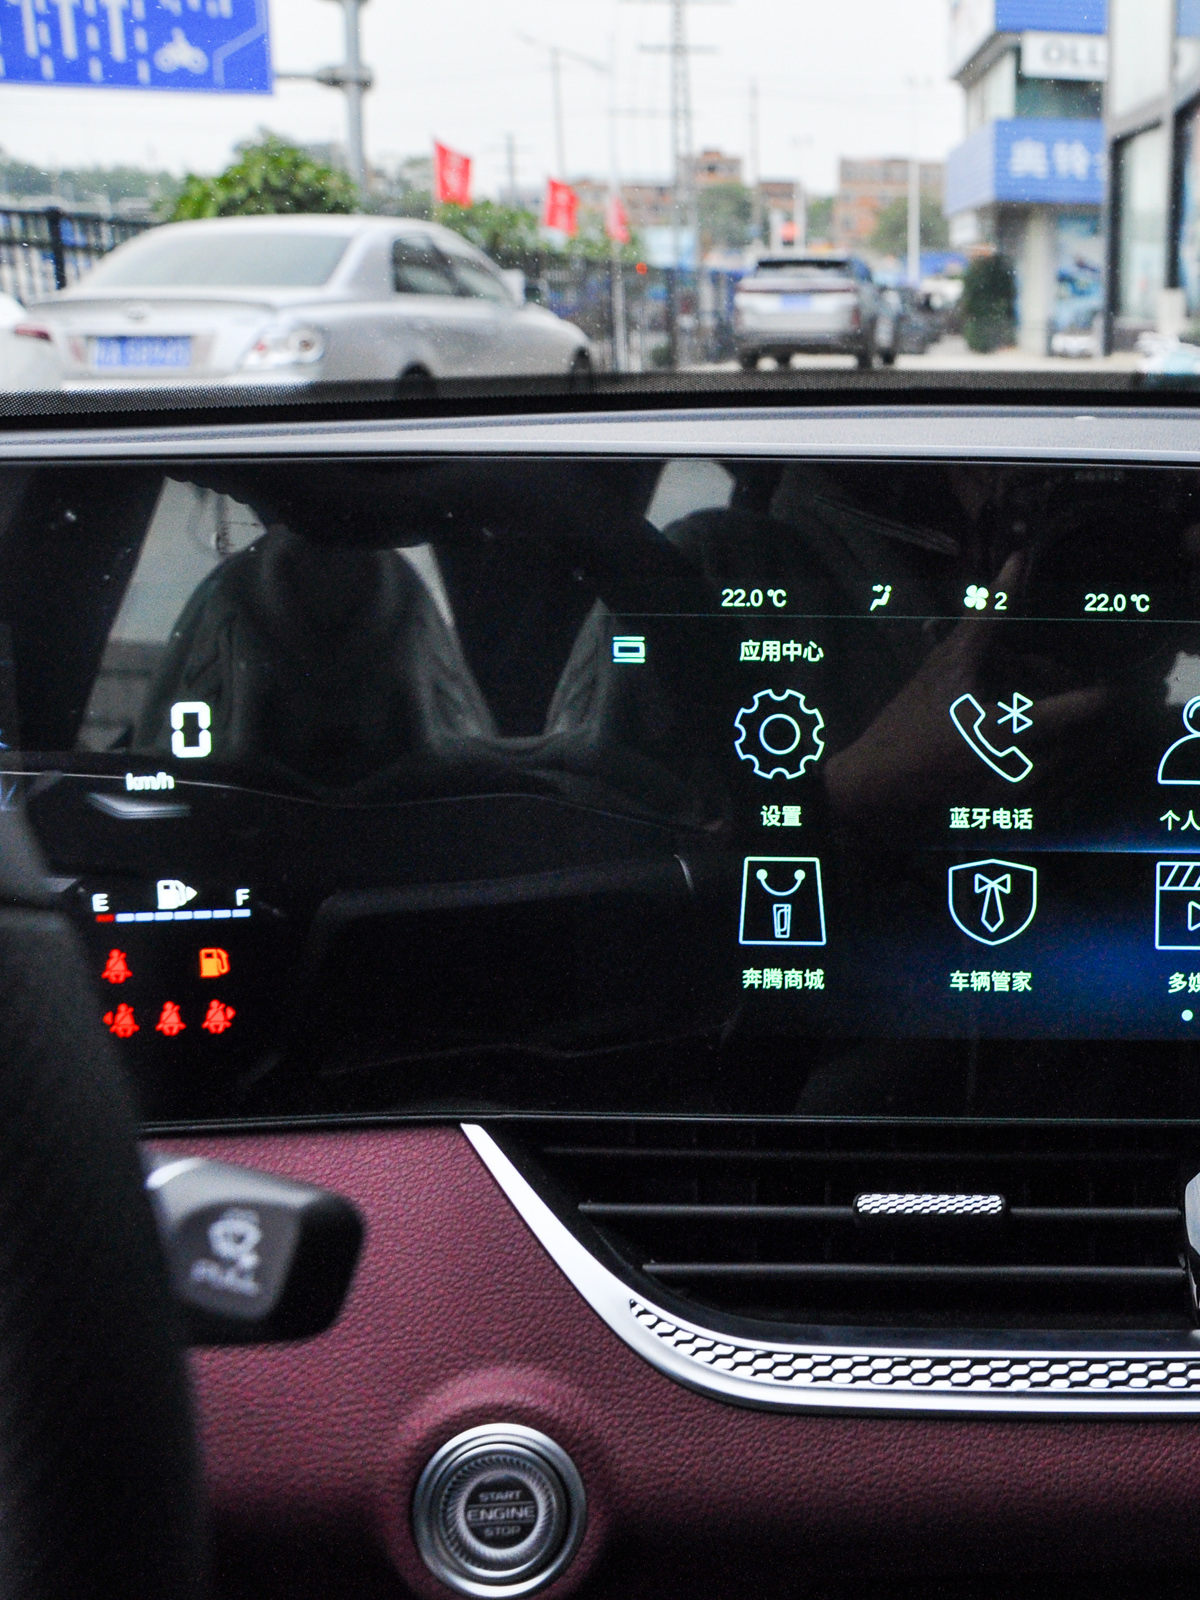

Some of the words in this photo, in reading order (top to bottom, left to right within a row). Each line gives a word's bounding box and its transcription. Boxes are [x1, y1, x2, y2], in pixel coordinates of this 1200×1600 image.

[994, 592, 1008, 611] 2
[739, 638, 825, 663] 应用中心
[170, 701, 212, 759] 0
[126, 772, 175, 791] km/h
[760, 804, 803, 827] 设置
[948, 806, 1034, 830] 蓝牙电话
[92, 894, 109, 912] E
[235, 888, 251, 907] F
[742, 967, 825, 990] 奔腾商城
[949, 969, 1033, 993] 车辆管家
[479, 1490, 521, 1502] START
[467, 1506, 535, 1520] ENGINE
[484, 1526, 521, 1537] STOP
